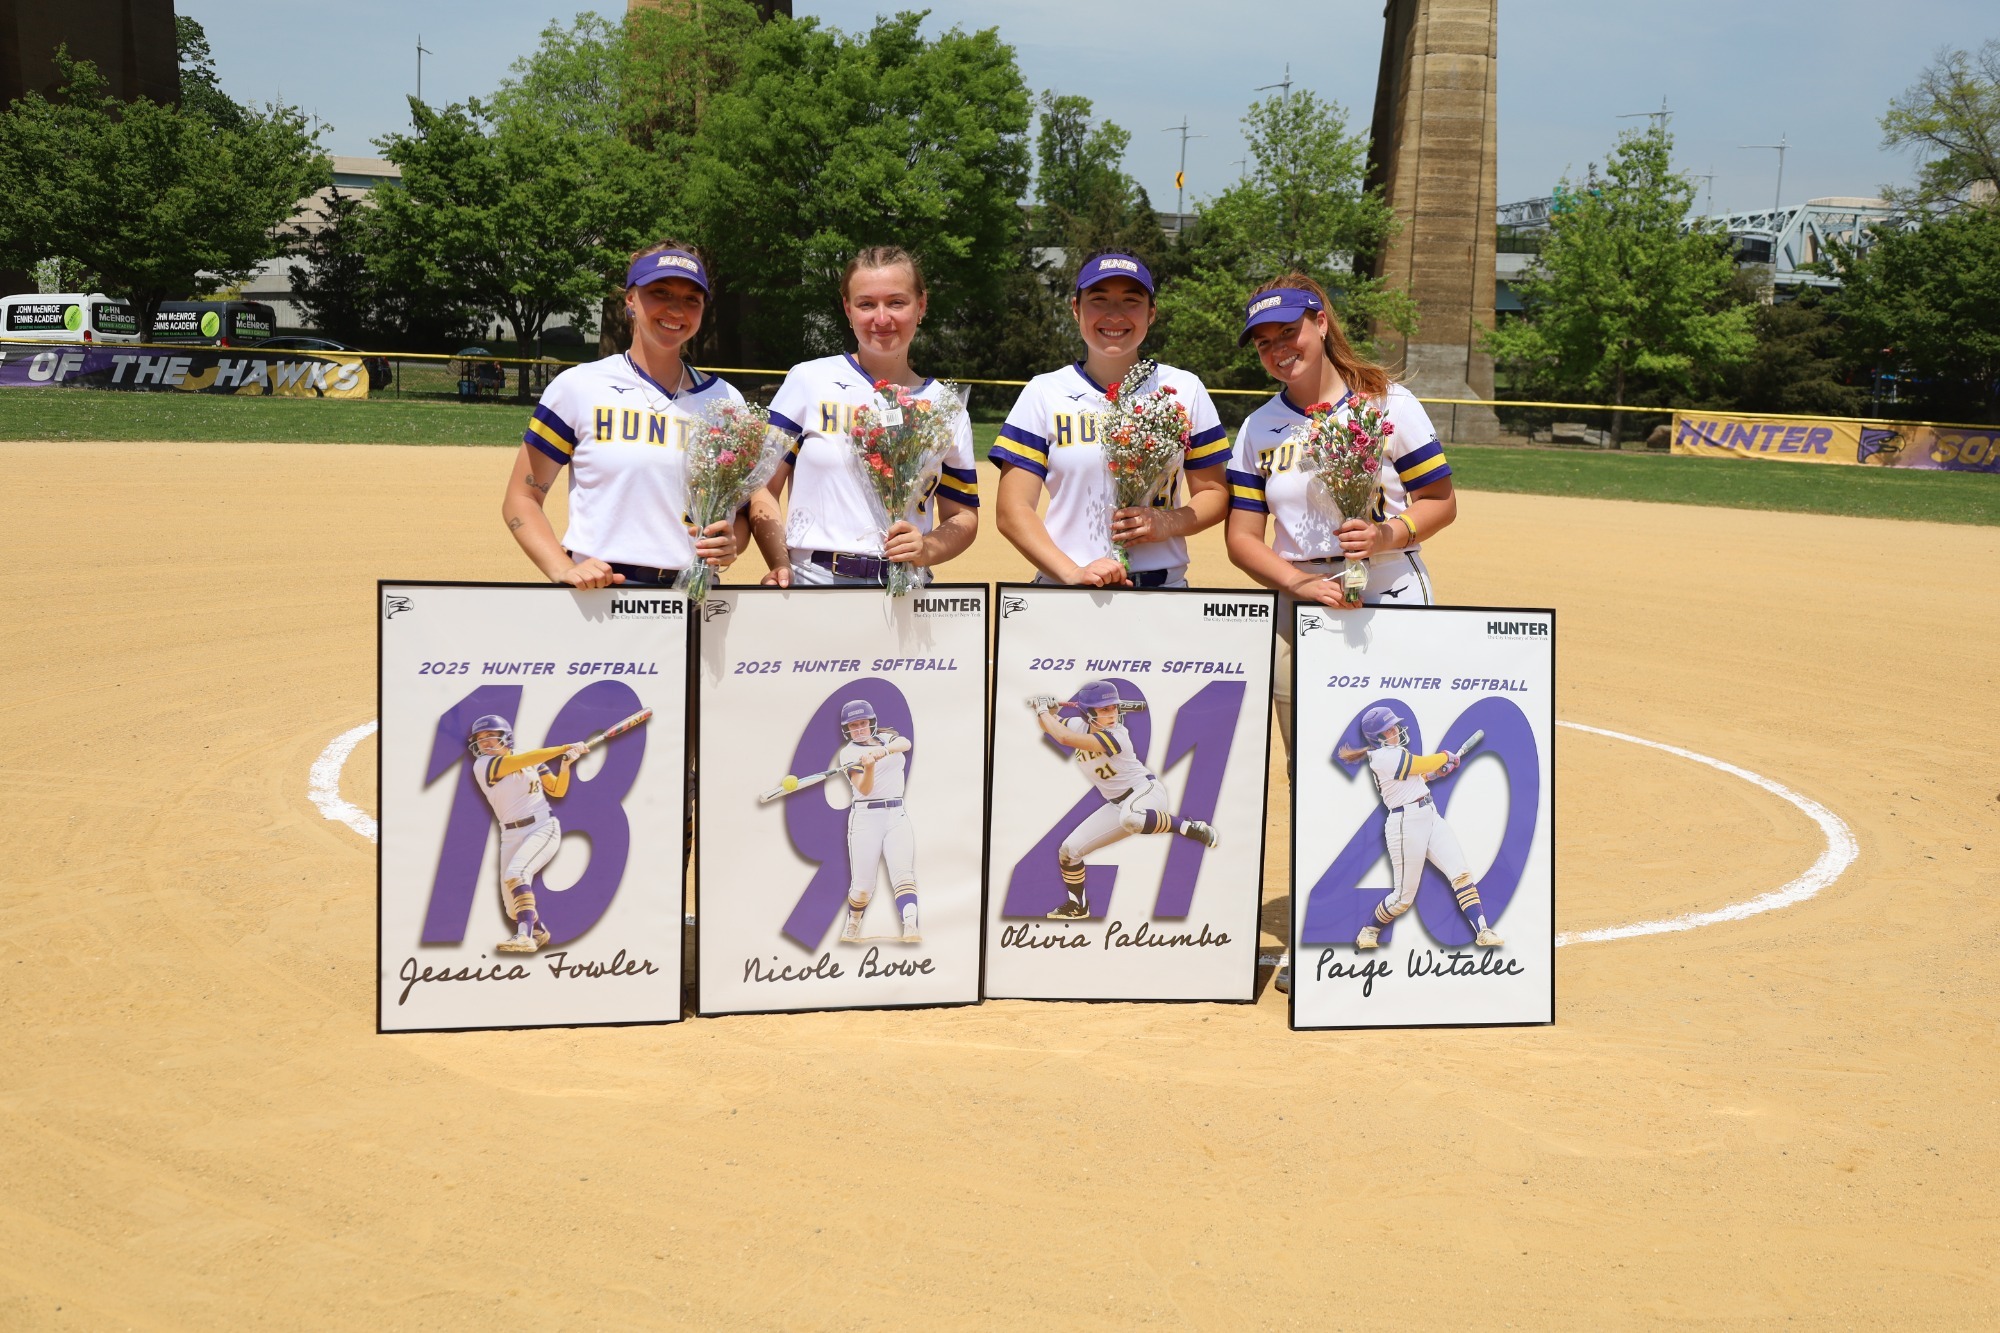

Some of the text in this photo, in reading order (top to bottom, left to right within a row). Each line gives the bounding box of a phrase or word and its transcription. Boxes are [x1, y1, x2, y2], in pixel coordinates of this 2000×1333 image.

[657, 255, 698, 273] HUNTER
[1099, 258, 1138, 272] HUNTER
[16, 305, 60, 314] JOHN McENROE
[1249, 295, 1282, 318] HUNTER
[14, 315, 33, 323] TENNIS
[34, 315, 62, 323] ACADEMY
[99, 314, 135, 323] McENROE
[155, 312, 196, 320] OHN McENROE
[153, 322, 169, 331] ENNIS
[170, 322, 198, 330] ACADEMY
[236, 321, 270, 330] McENROE
[28, 353, 85, 382] OF
[112, 355, 193, 385] THE
[215, 358, 363, 391] HAWKS
[1676, 420, 1833, 454] HUNTER
[611, 600, 683, 614] HUNTER
[914, 599, 981, 612] HUNTER
[1203, 603, 1269, 617] HUNTER
[1487, 622, 1548, 635] HUNTER
[418, 662, 659, 675] 2025 HUNTER SOFTBALL
[734, 658, 958, 675] 2025 HUNTER SOFTBALL
[1029, 658, 1245, 675] 2025 HUNTER SOFTBALL
[1327, 676, 1529, 692] 2025 HUNTER SOFTBALL
[1095, 763, 1117, 780] 21
[1002, 678, 1247, 918] 21
[420, 679, 647, 946] 18
[782, 677, 914, 951] 9
[1301, 696, 1540, 946] 20
[1001, 920, 1231, 950] Olivia Palumbo
[743, 946, 936, 984] Nicole Bowe
[1317, 948, 1524, 998] Paige Witalec
[398, 949, 659, 1007] Jessica Fowler
